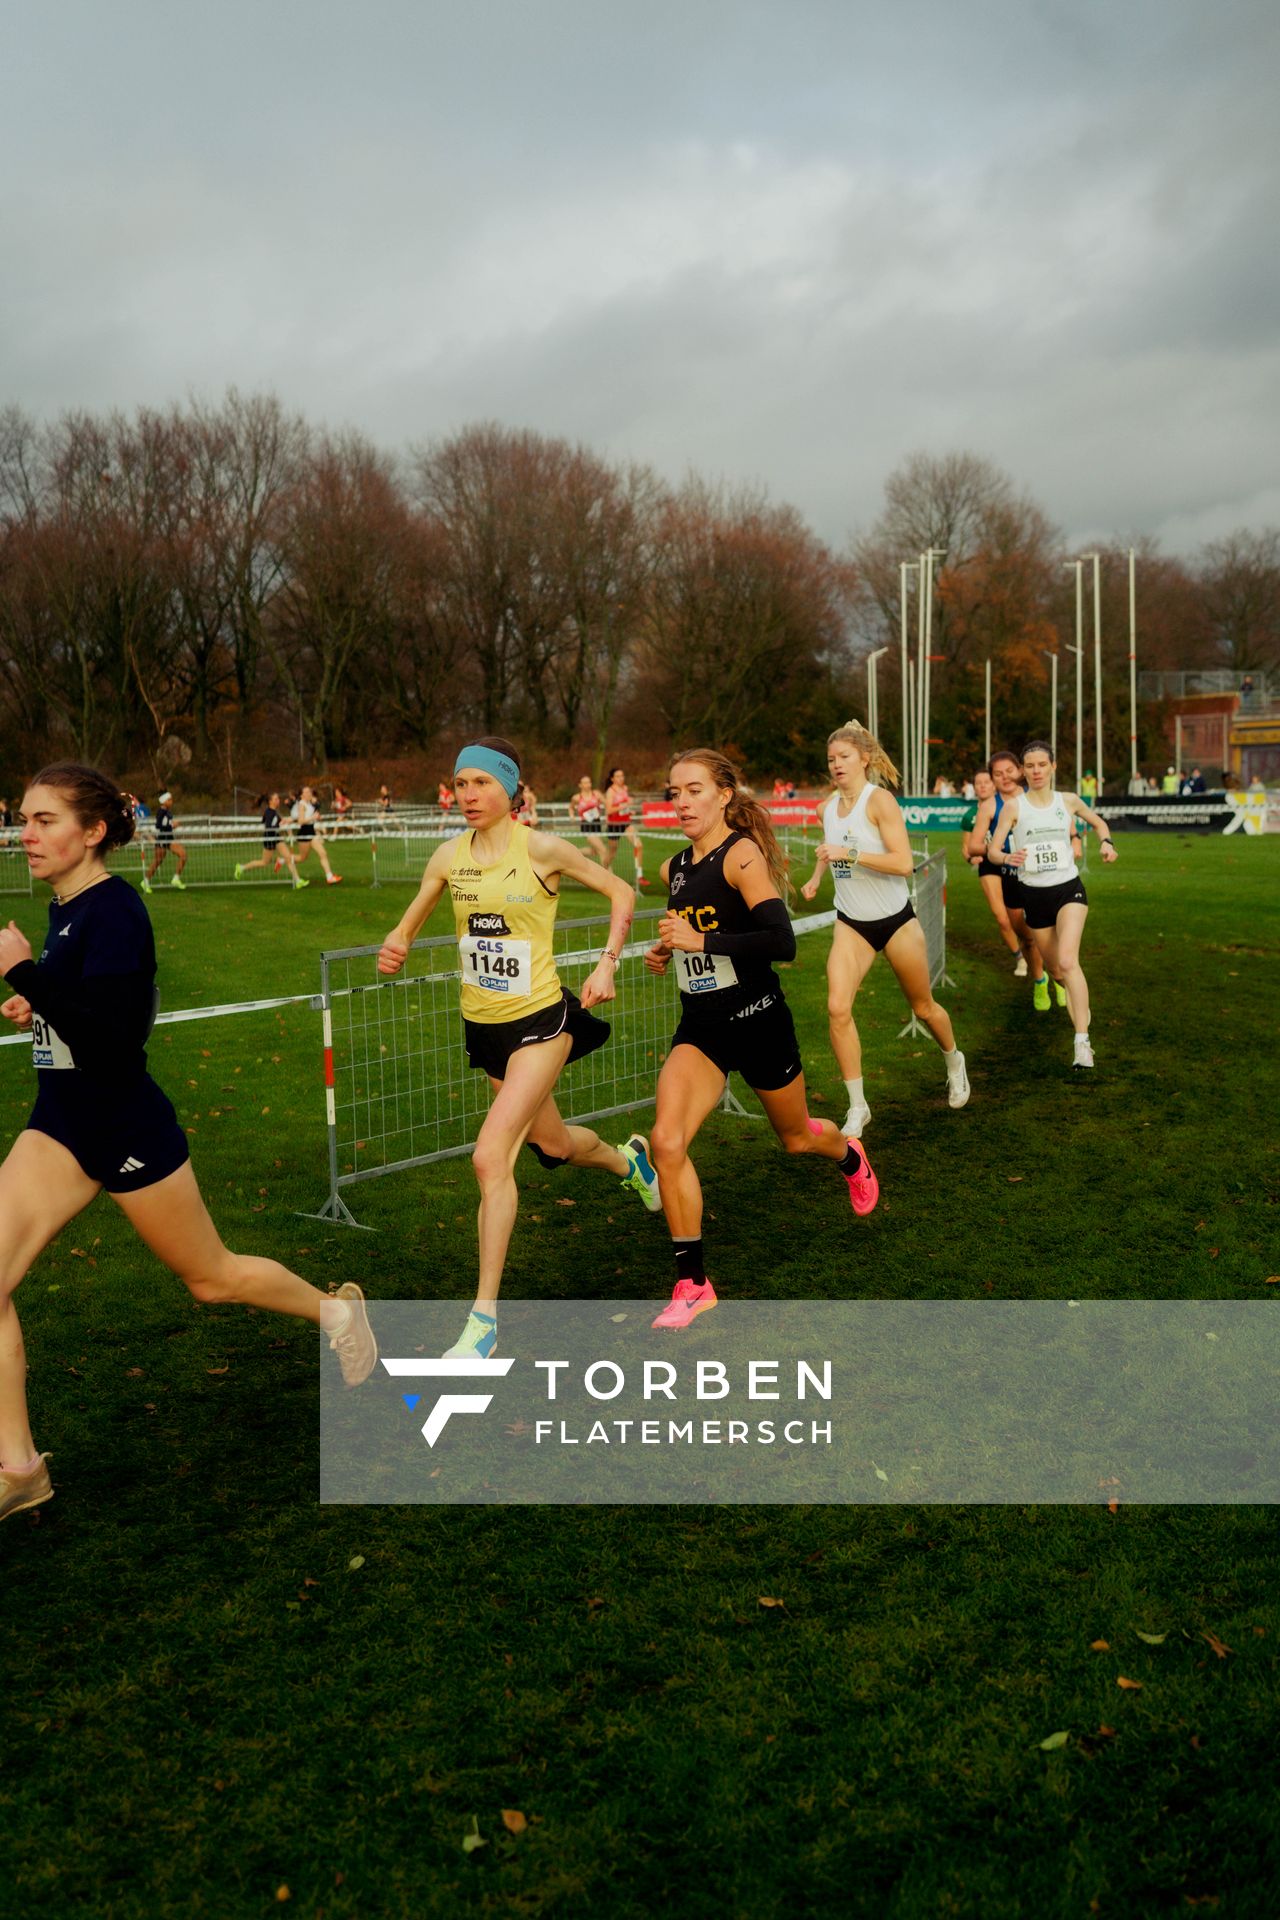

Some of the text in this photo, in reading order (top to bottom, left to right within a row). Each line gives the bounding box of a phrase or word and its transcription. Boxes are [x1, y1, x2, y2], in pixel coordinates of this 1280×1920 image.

[1035, 851, 1058, 864] 158
[473, 918, 503, 929] HOKA
[477, 940, 503, 953] GLS
[469, 952, 520, 977] 1148
[683, 954, 716, 977] 104
[490, 979, 508, 988] PLAN
[699, 978, 715, 987] PLAN
[33, 1019, 51, 1046] 91
